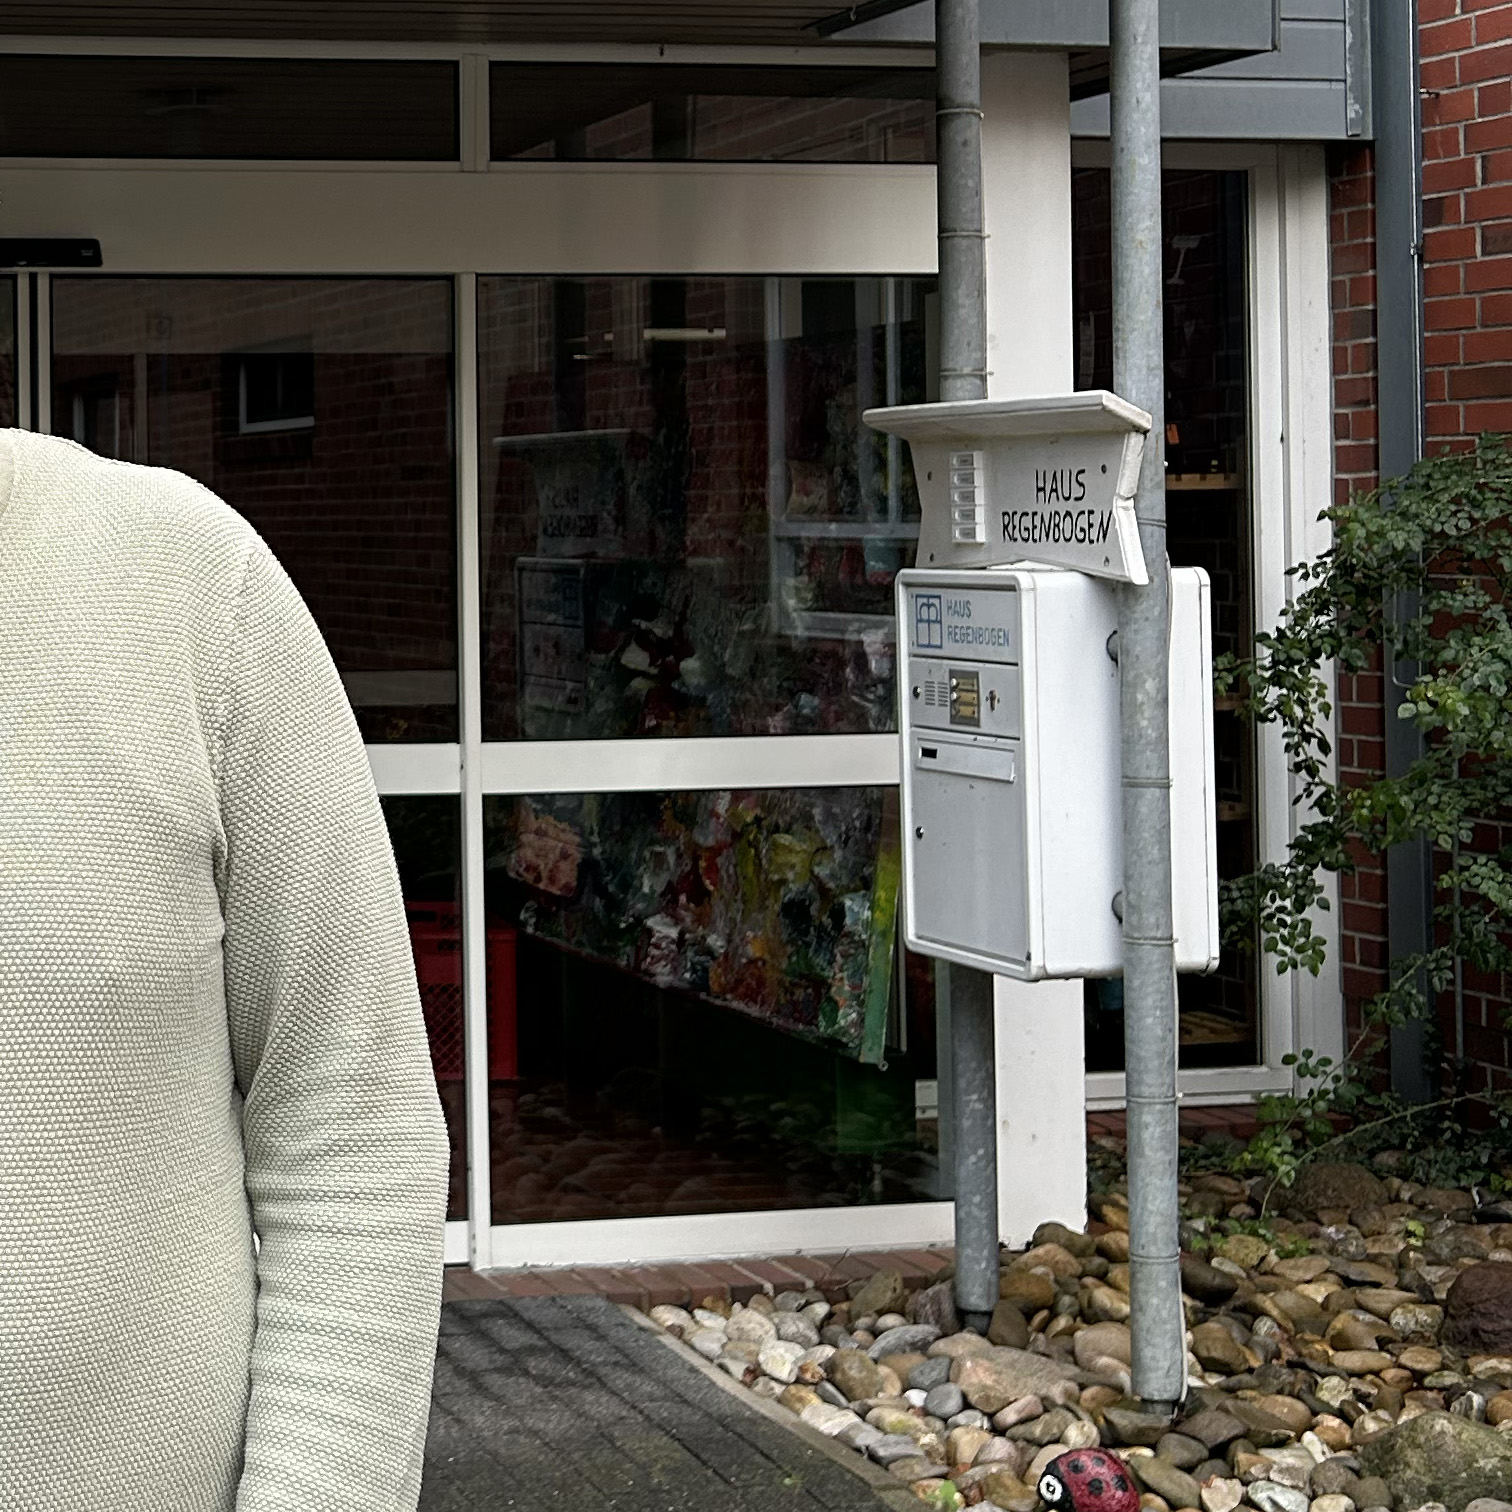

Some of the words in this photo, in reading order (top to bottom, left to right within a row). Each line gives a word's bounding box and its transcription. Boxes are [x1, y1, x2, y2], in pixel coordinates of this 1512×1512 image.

[1035, 468, 1086, 504] HAUS
[1001, 509, 1113, 544] REGENBOGEN
[946, 599, 972, 619] HAUS
[947, 625, 1010, 647] REGENBOGEN
